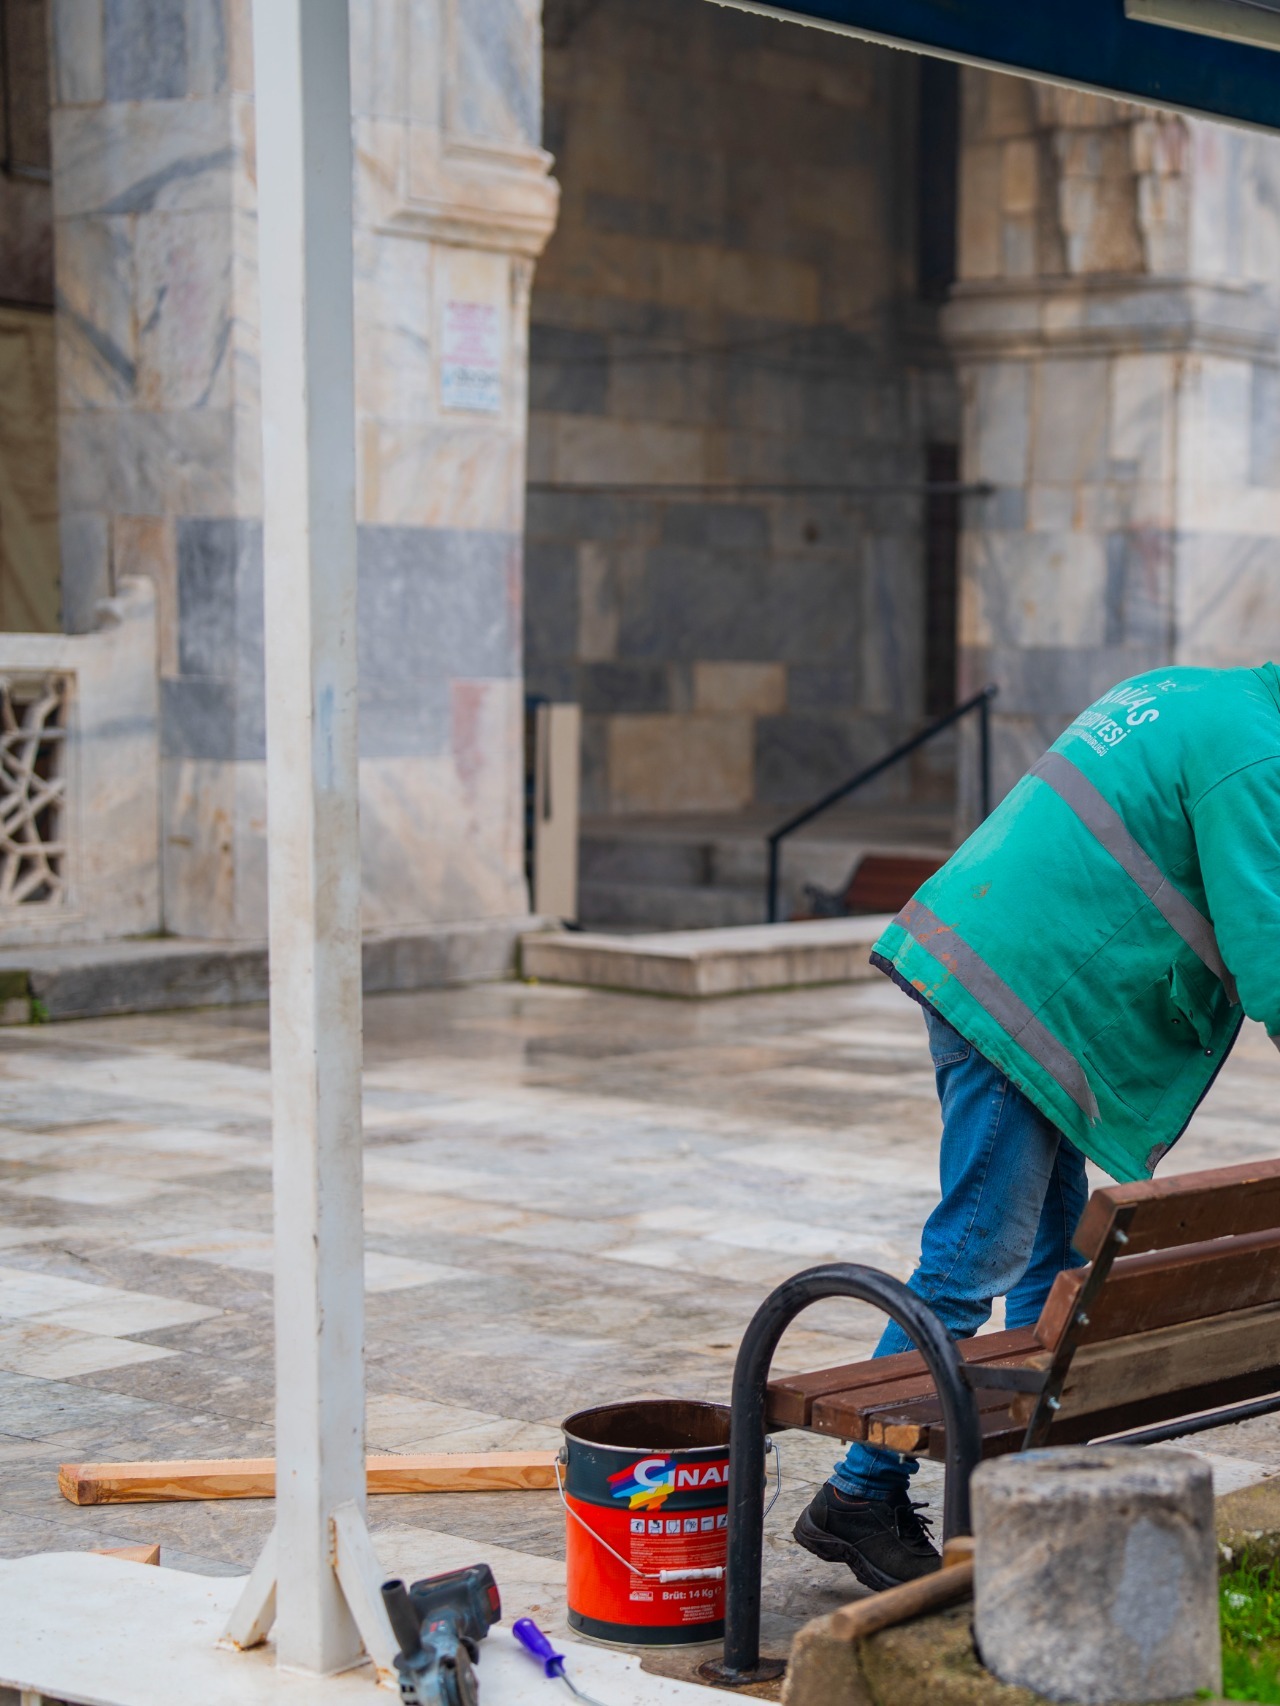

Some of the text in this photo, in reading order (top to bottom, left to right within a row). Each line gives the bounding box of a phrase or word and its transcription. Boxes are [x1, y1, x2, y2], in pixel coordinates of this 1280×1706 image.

[1093, 684, 1160, 726] MİLAS
[662, 1591, 687, 1600] Brüt:
[688, 1590, 700, 1598] 14
[701, 1588, 714, 1598] Kg
